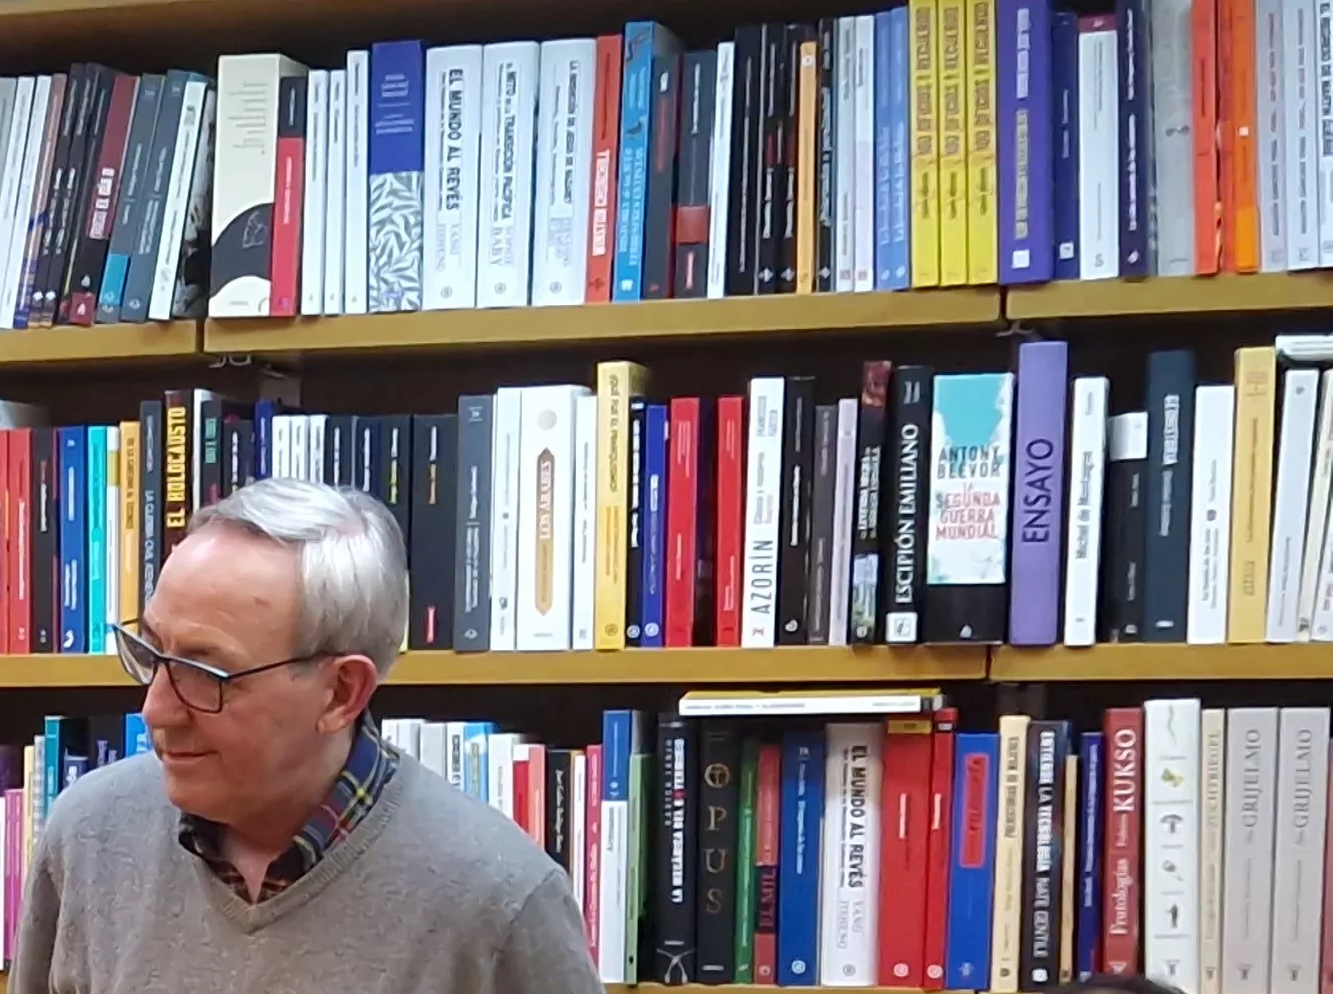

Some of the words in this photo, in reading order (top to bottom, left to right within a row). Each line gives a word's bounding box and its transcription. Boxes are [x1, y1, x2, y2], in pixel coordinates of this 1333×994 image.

[449, 69, 463, 85] EL
[448, 90, 462, 140] MUNDO
[447, 145, 462, 161] AL
[446, 167, 461, 211] REVÉS
[167, 407, 186, 502] HOLOCAUSTO
[898, 424, 919, 514] EMILIANO
[937, 462, 1001, 479] BEEVOR
[939, 446, 1001, 461] ANTONY
[935, 492, 1001, 509] SEGUNDA
[1022, 439, 1054, 543] ENSAYO
[167, 508, 186, 528] EL
[936, 524, 997, 540] MUNDIAL
[940, 509, 995, 524] GUERRA
[750, 539, 773, 615] AZORÍN
[894, 520, 915, 603] ESCIPIÓN
[852, 746, 868, 761] EL
[1113, 728, 1137, 812] KUKSO
[850, 768, 867, 818] MUNDO
[1242, 728, 1261, 828] GRIJELMO
[1294, 728, 1313, 829] GRIJELMO
[704, 762, 731, 914] OPUS
[849, 822, 865, 839] AL
[848, 844, 866, 888] REVÉS
